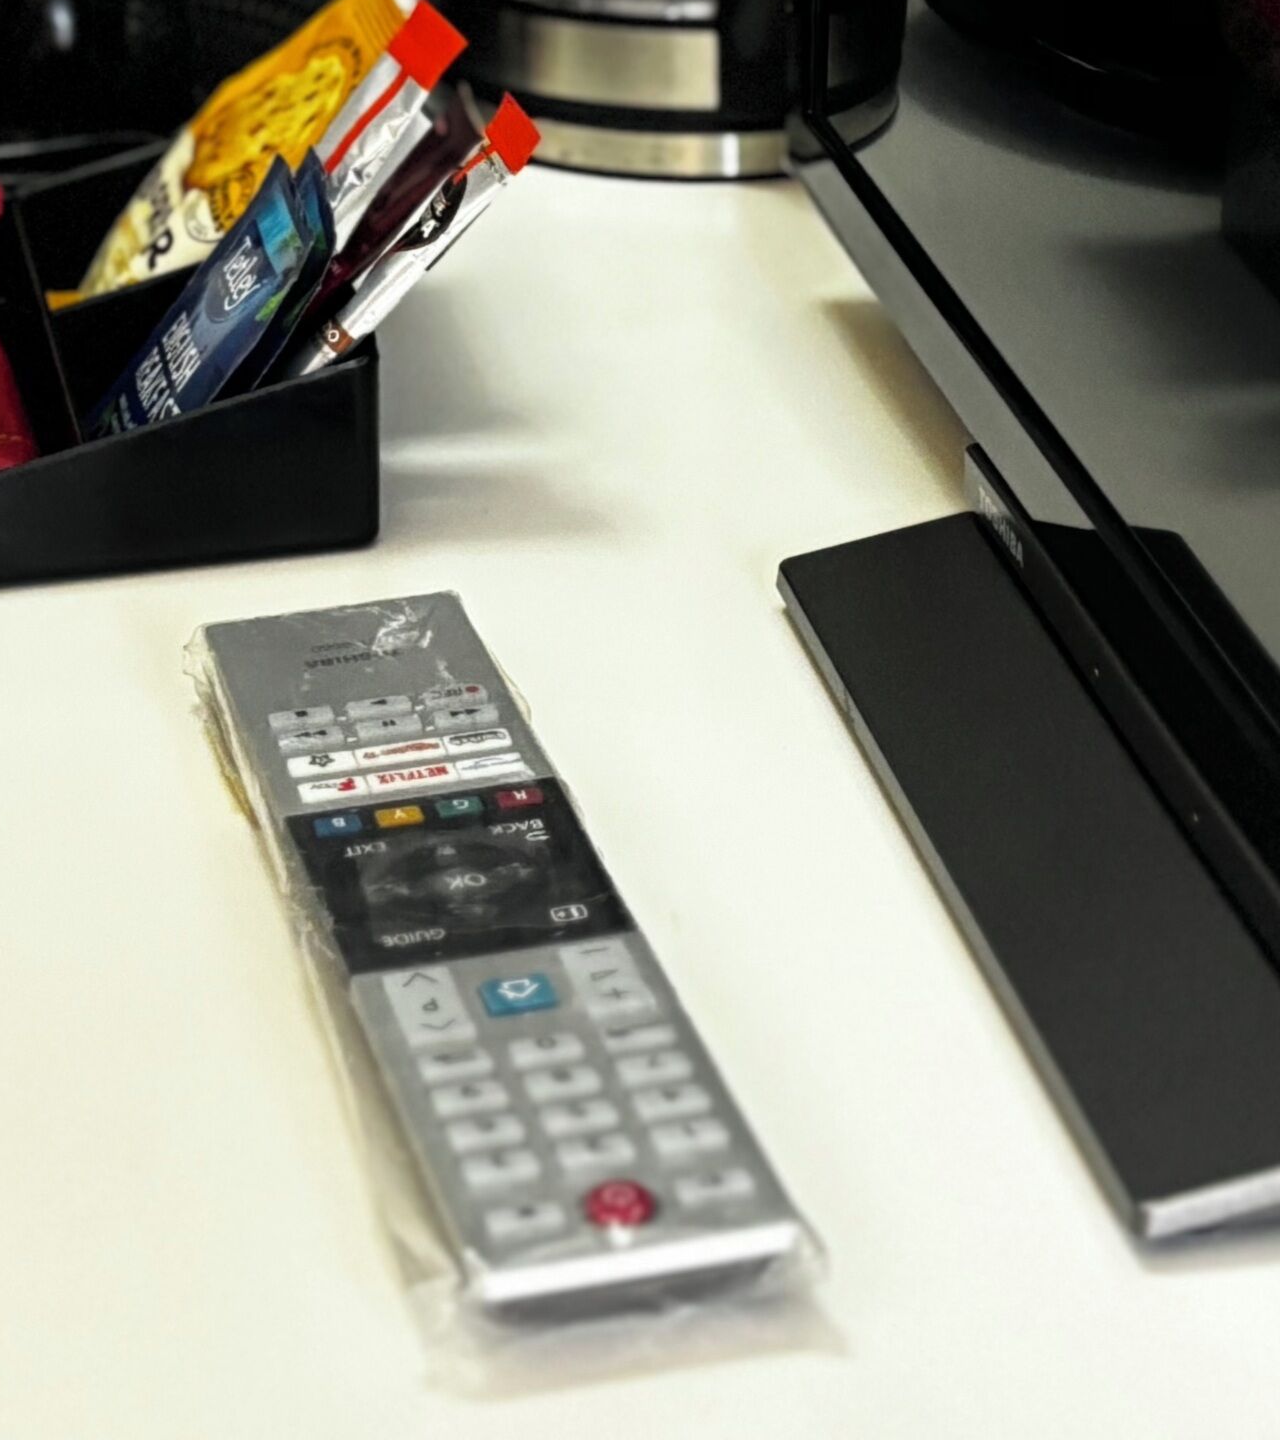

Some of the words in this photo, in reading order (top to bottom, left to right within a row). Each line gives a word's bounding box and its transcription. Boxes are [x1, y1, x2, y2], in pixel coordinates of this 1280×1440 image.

[223, 235, 268, 311] Tetley
[161, 312, 202, 394] ENGLISH
[377, 764, 450, 785] NETFLIX
[452, 798, 469, 810] G
[332, 817, 347, 829] B
[393, 809, 408, 820] Y
[488, 817, 546, 836] BACK
[344, 841, 388, 859] EXIT
[444, 872, 488, 891] OK
[381, 927, 447, 948] GUIDE
[423, 997, 439, 1013] P
